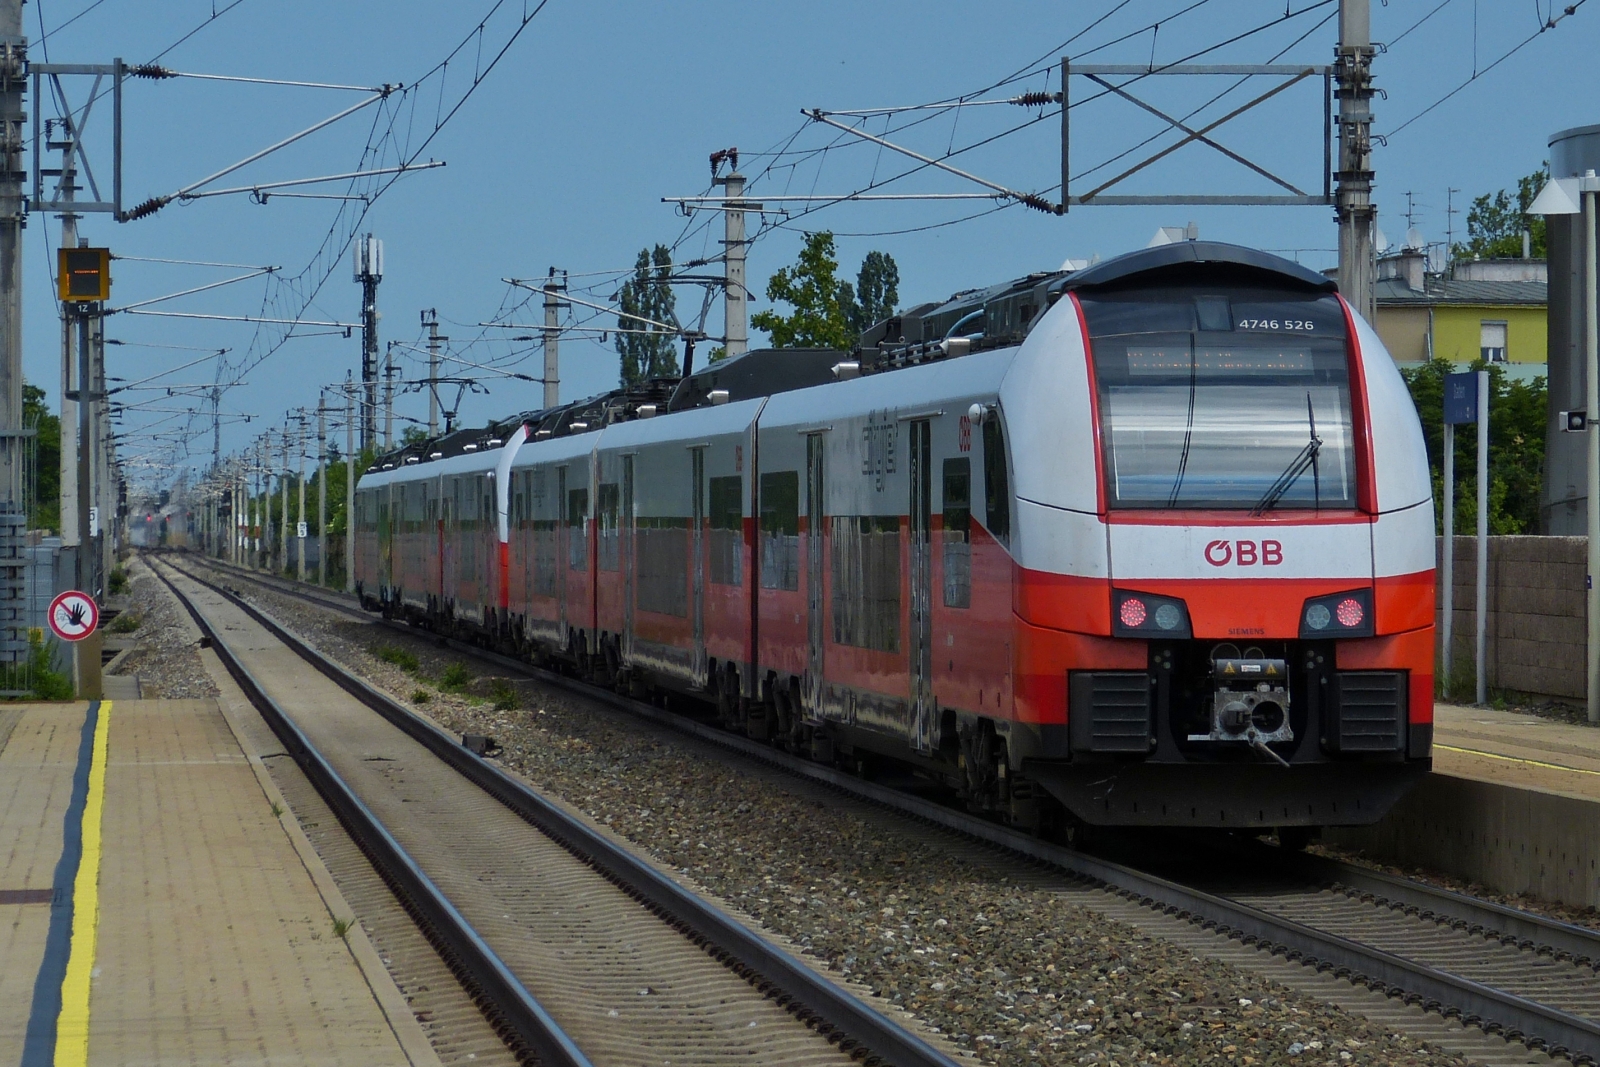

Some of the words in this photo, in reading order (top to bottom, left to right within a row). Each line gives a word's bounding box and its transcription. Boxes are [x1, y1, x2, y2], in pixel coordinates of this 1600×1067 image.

[1240, 320, 1279, 329] 4746
[1285, 321, 1314, 330] 526
[1204, 540, 1283, 566] ÖBB
